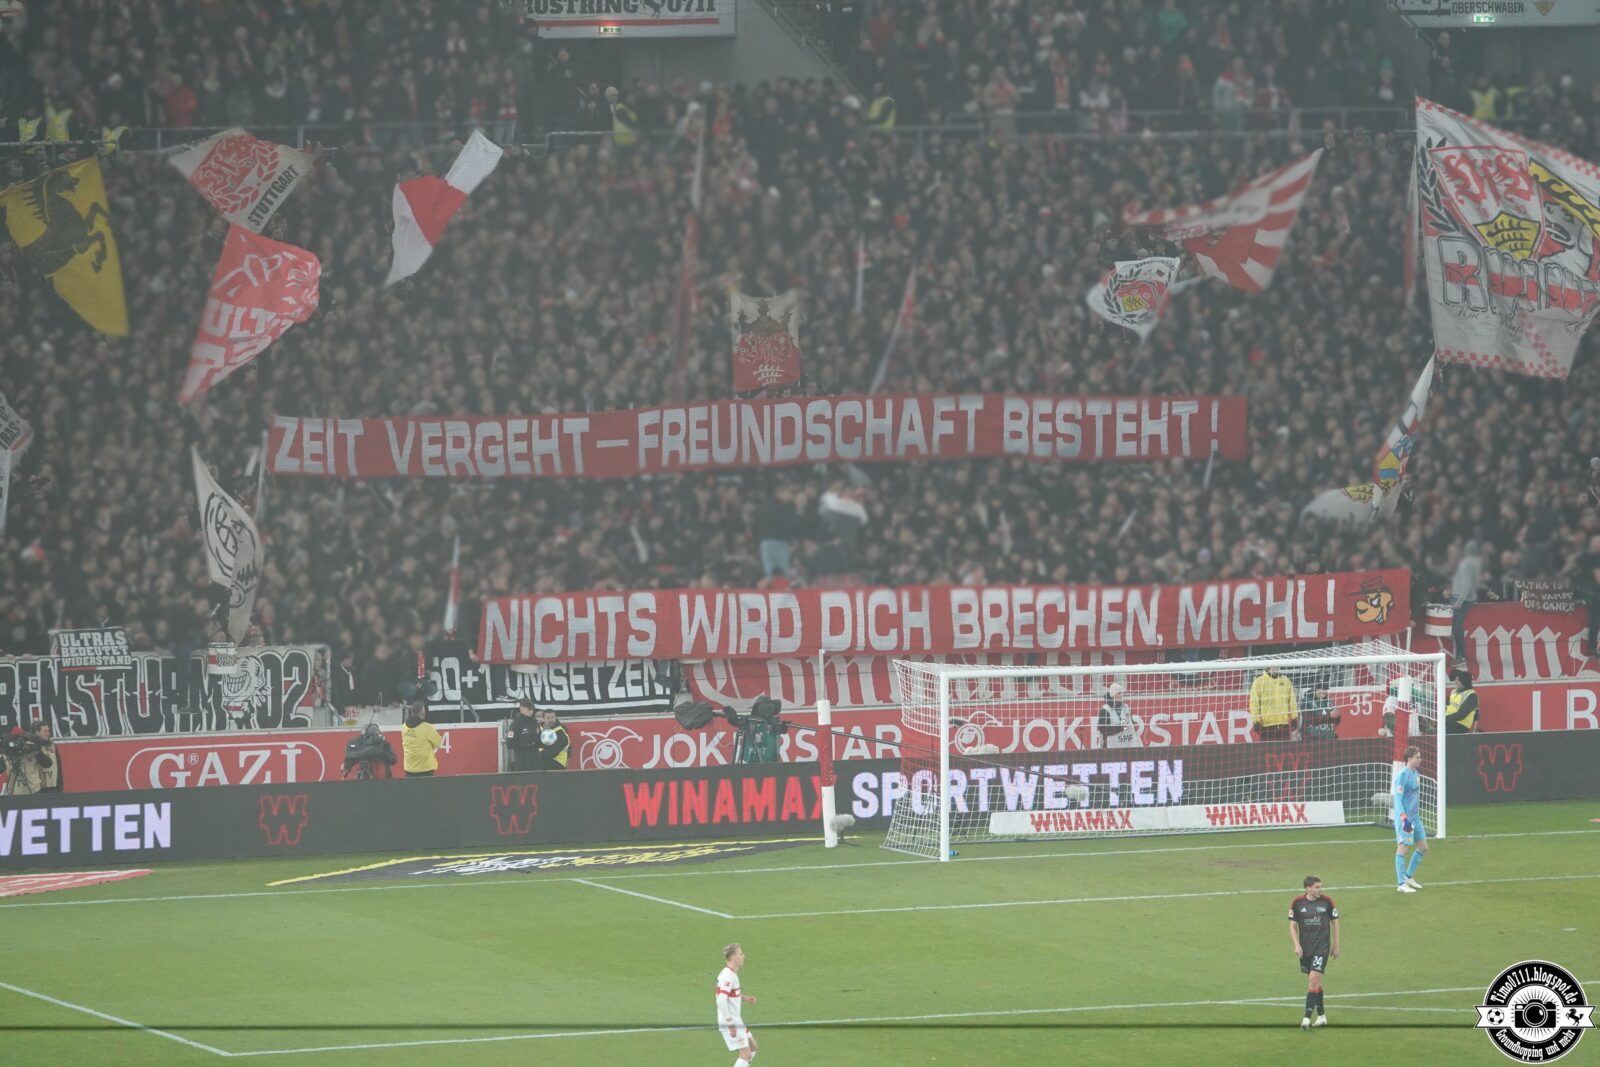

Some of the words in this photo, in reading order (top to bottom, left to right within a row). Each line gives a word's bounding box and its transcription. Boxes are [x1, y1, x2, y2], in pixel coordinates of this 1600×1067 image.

[1452, 2, 1524, 14] OBERSCHWABEN
[248, 165, 299, 226] STUTTGART
[273, 416, 364, 476] ZEIT
[384, 417, 590, 477] VERGEHT
[638, 396, 984, 469] FREUNDSCHAFT
[483, 592, 656, 661] NICHTS
[679, 593, 802, 655] WIRD
[820, 590, 932, 652] DICH
[950, 586, 1163, 649] BRECHEN,
[1177, 578, 1336, 646] MICHL!
[59, 631, 127, 647] ULTRAS
[61, 646, 128, 657] BEDEUTET
[62, 656, 131, 667] WIDERSTAND
[1350, 693, 1373, 716] 35
[642, 723, 904, 769] JOKRSAR
[851, 759, 1183, 819] SPORTWETTEN
[1030, 810, 1133, 834] WINAMAX
[1206, 803, 1309, 827] WINAMAX
